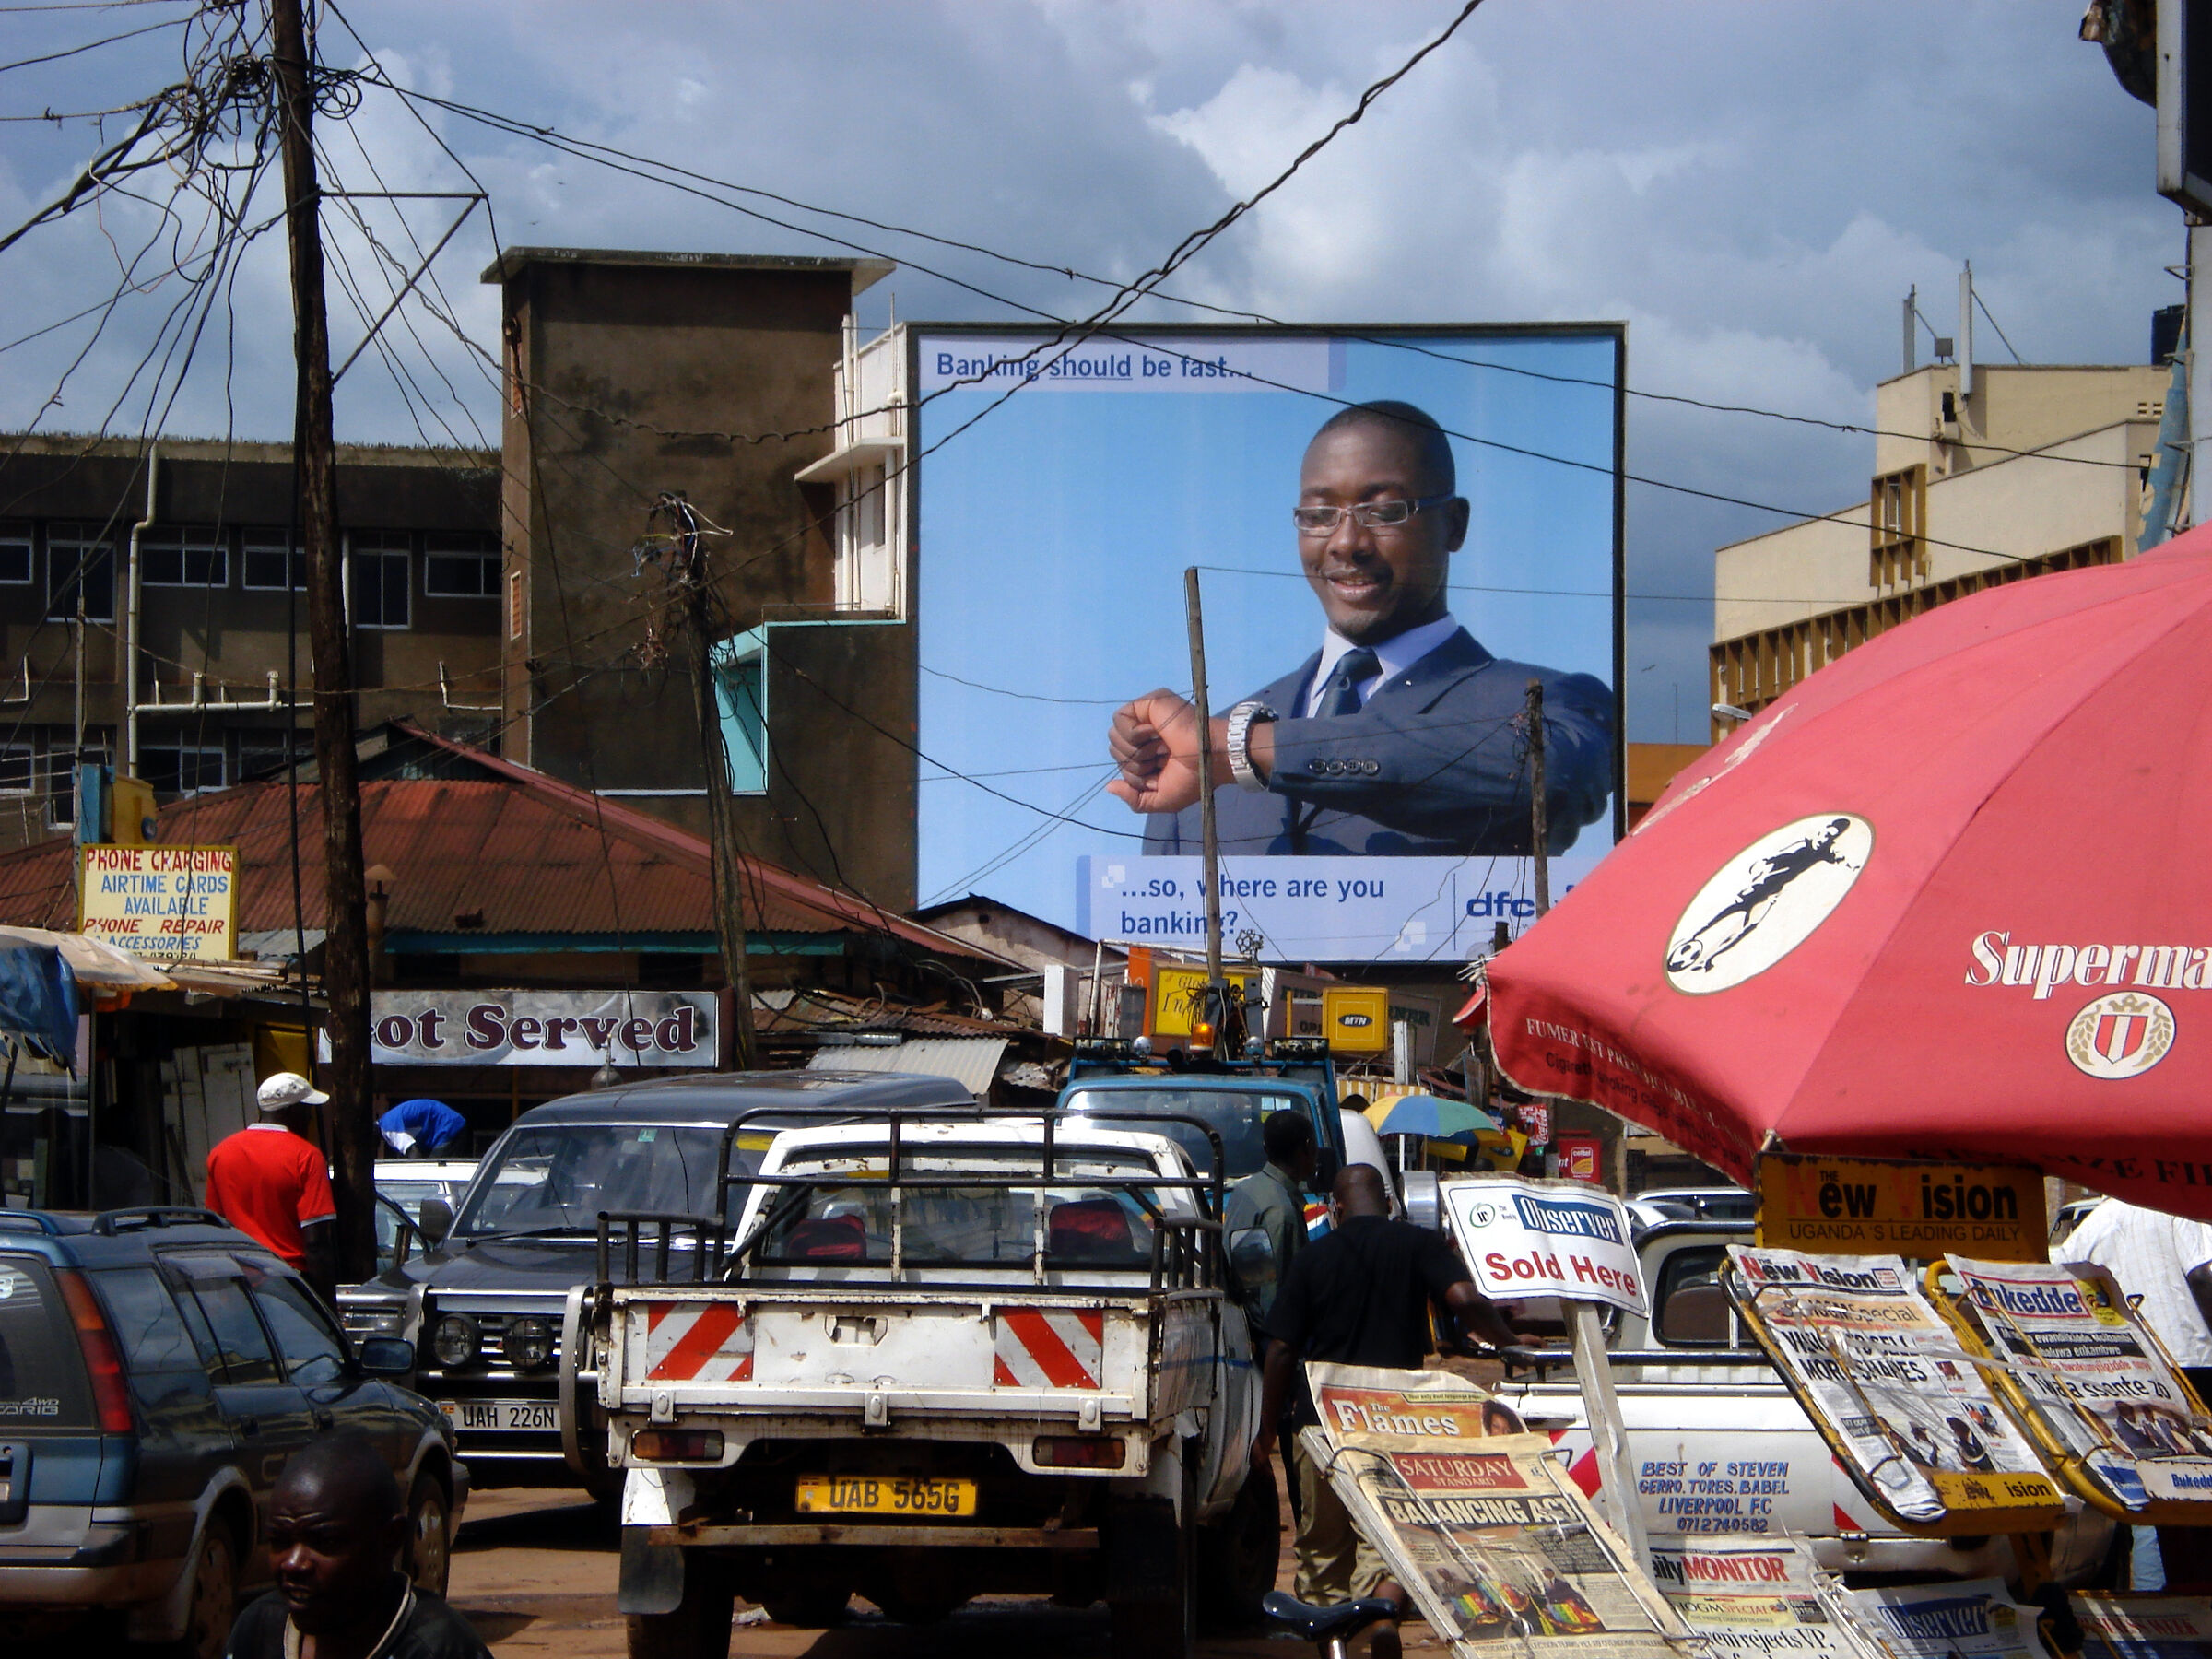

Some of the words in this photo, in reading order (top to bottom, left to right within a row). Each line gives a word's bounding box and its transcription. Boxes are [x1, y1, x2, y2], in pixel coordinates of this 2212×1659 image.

[936, 352, 1040, 381] Banking
[1049, 355, 1133, 380] should
[1142, 355, 1171, 377] be
[86, 849, 143, 871] PHONE
[151, 850, 232, 873] CHARGING
[101, 875, 167, 893] AIRTIME
[175, 875, 229, 893] CARDS
[1288, 879, 1329, 898] are
[1337, 879, 1384, 903] you
[124, 897, 209, 915] AVAILABLE
[1466, 891, 1537, 918] dfc
[83, 918, 143, 934] PHONE
[159, 919, 225, 934] REPAIR
[109, 935, 202, 950] ACCESSORIES
[1964, 930, 2212, 1000] Superma
[361, 1007, 446, 1052] ot
[463, 1003, 699, 1053] Served
[1344, 1016, 1367, 1025] MTN
[1526, 1018, 1580, 1048] FUMER
[1818, 1170, 1839, 1182] THE
[1786, 1165, 1877, 1218] New
[1889, 1169, 2018, 1220] Vision
[1520, 1197, 1618, 1241] Observer
[1789, 1223, 1865, 1241] UGANDA
[1891, 1225, 1967, 1241] LEADING
[1972, 1225, 2021, 1241] DAILY
[1485, 1251, 1566, 1281] Sold
[1570, 1255, 1637, 1297] Here
[1739, 1255, 1801, 1281] New
[1797, 1260, 1879, 1288] Vision
[1970, 1277, 2084, 1314] Bukedde
[2028, 1372, 2084, 1398] Twaa
[2148, 1379, 2171, 1399] zo
[21, 1397, 59, 1406] 4WD
[1369, 1402, 1391, 1413] The
[463, 1406, 498, 1428] UAH
[510, 1406, 555, 1428] 226N
[1331, 1398, 1462, 1437] Flames
[1399, 1458, 1512, 1477] SATURDAY
[1641, 1461, 1688, 1477] BEST
[1697, 1461, 1718, 1477] OF
[1726, 1461, 1790, 1477] STEVEN
[830, 1479, 879, 1508] UAB
[1433, 1477, 1497, 1487] STANDARD
[1385, 1499, 1529, 1524] BALANCING
[1659, 1497, 1743, 1515] LIVERPOOL
[1680, 1556, 1790, 1582] MONITOR
[1879, 1606, 1988, 1639] Observer
[1740, 1629, 1803, 1653] rejects
